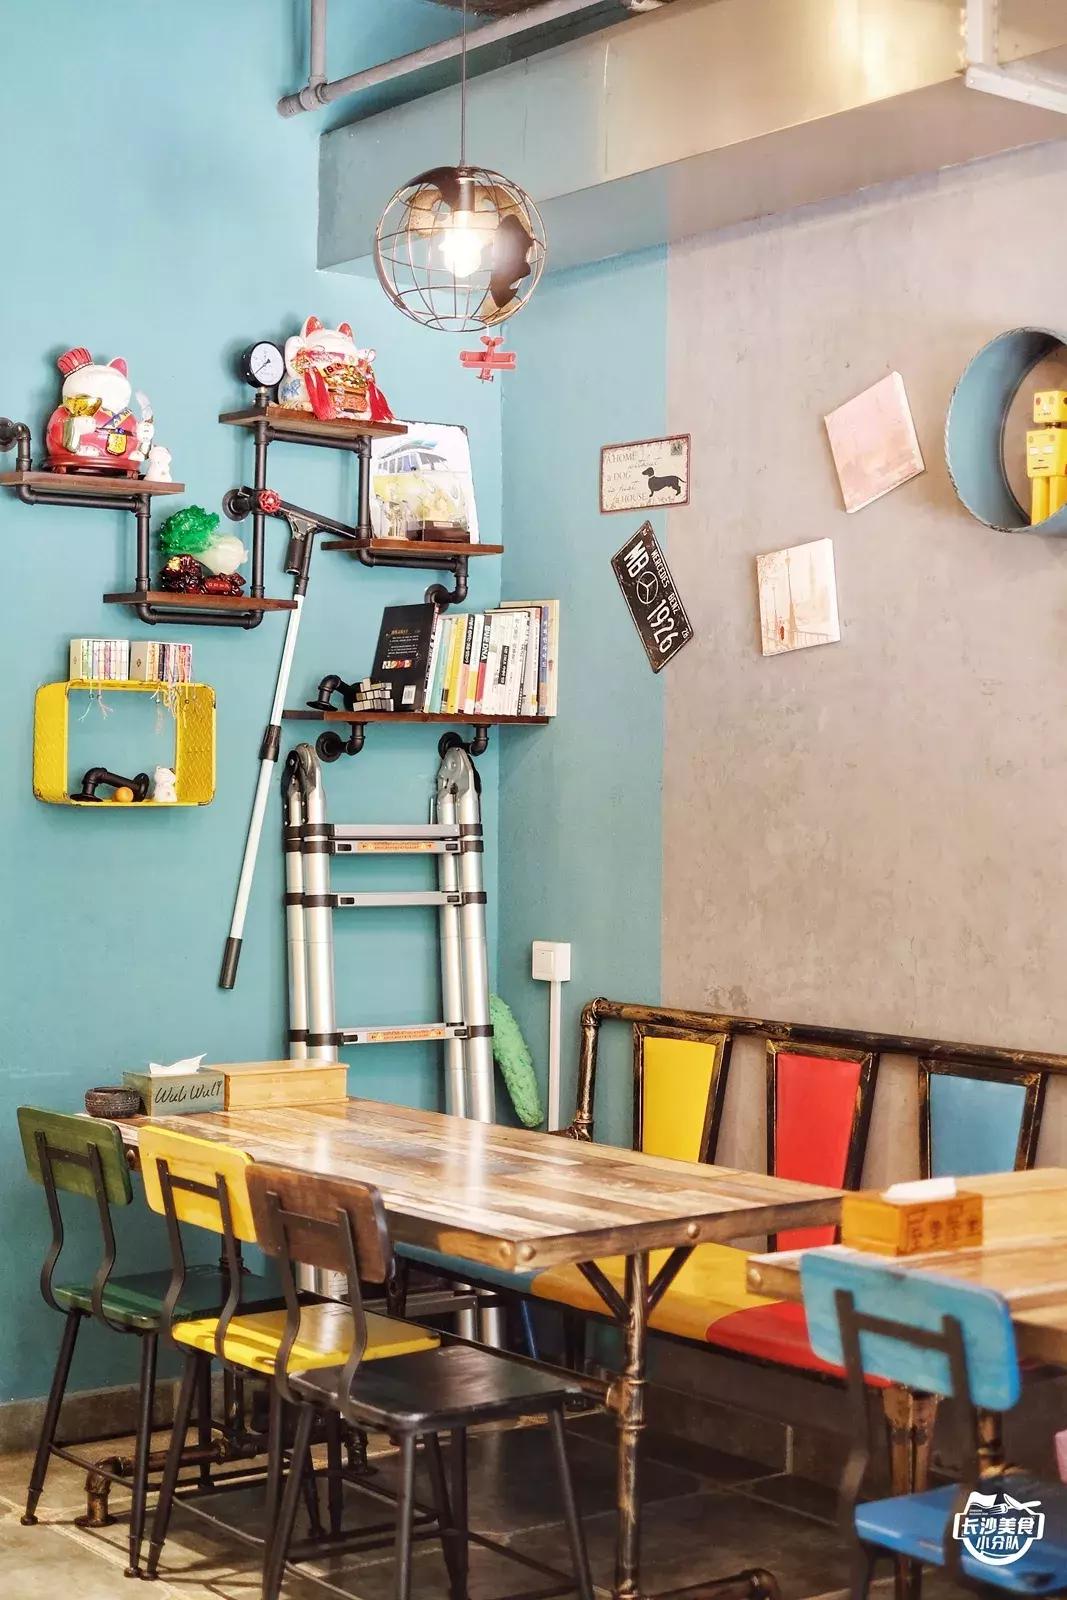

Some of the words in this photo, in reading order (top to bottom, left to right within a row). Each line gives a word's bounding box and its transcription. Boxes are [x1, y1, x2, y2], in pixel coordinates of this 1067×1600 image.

[613, 451, 637, 464] HOME
[613, 471, 632, 481] DOG
[620, 493, 648, 504] HOUSE
[650, 548, 670, 589] MERCEDES
[667, 592, 680, 615] BENZ
[623, 540, 650, 578] MB
[647, 598, 679, 654] 1926
